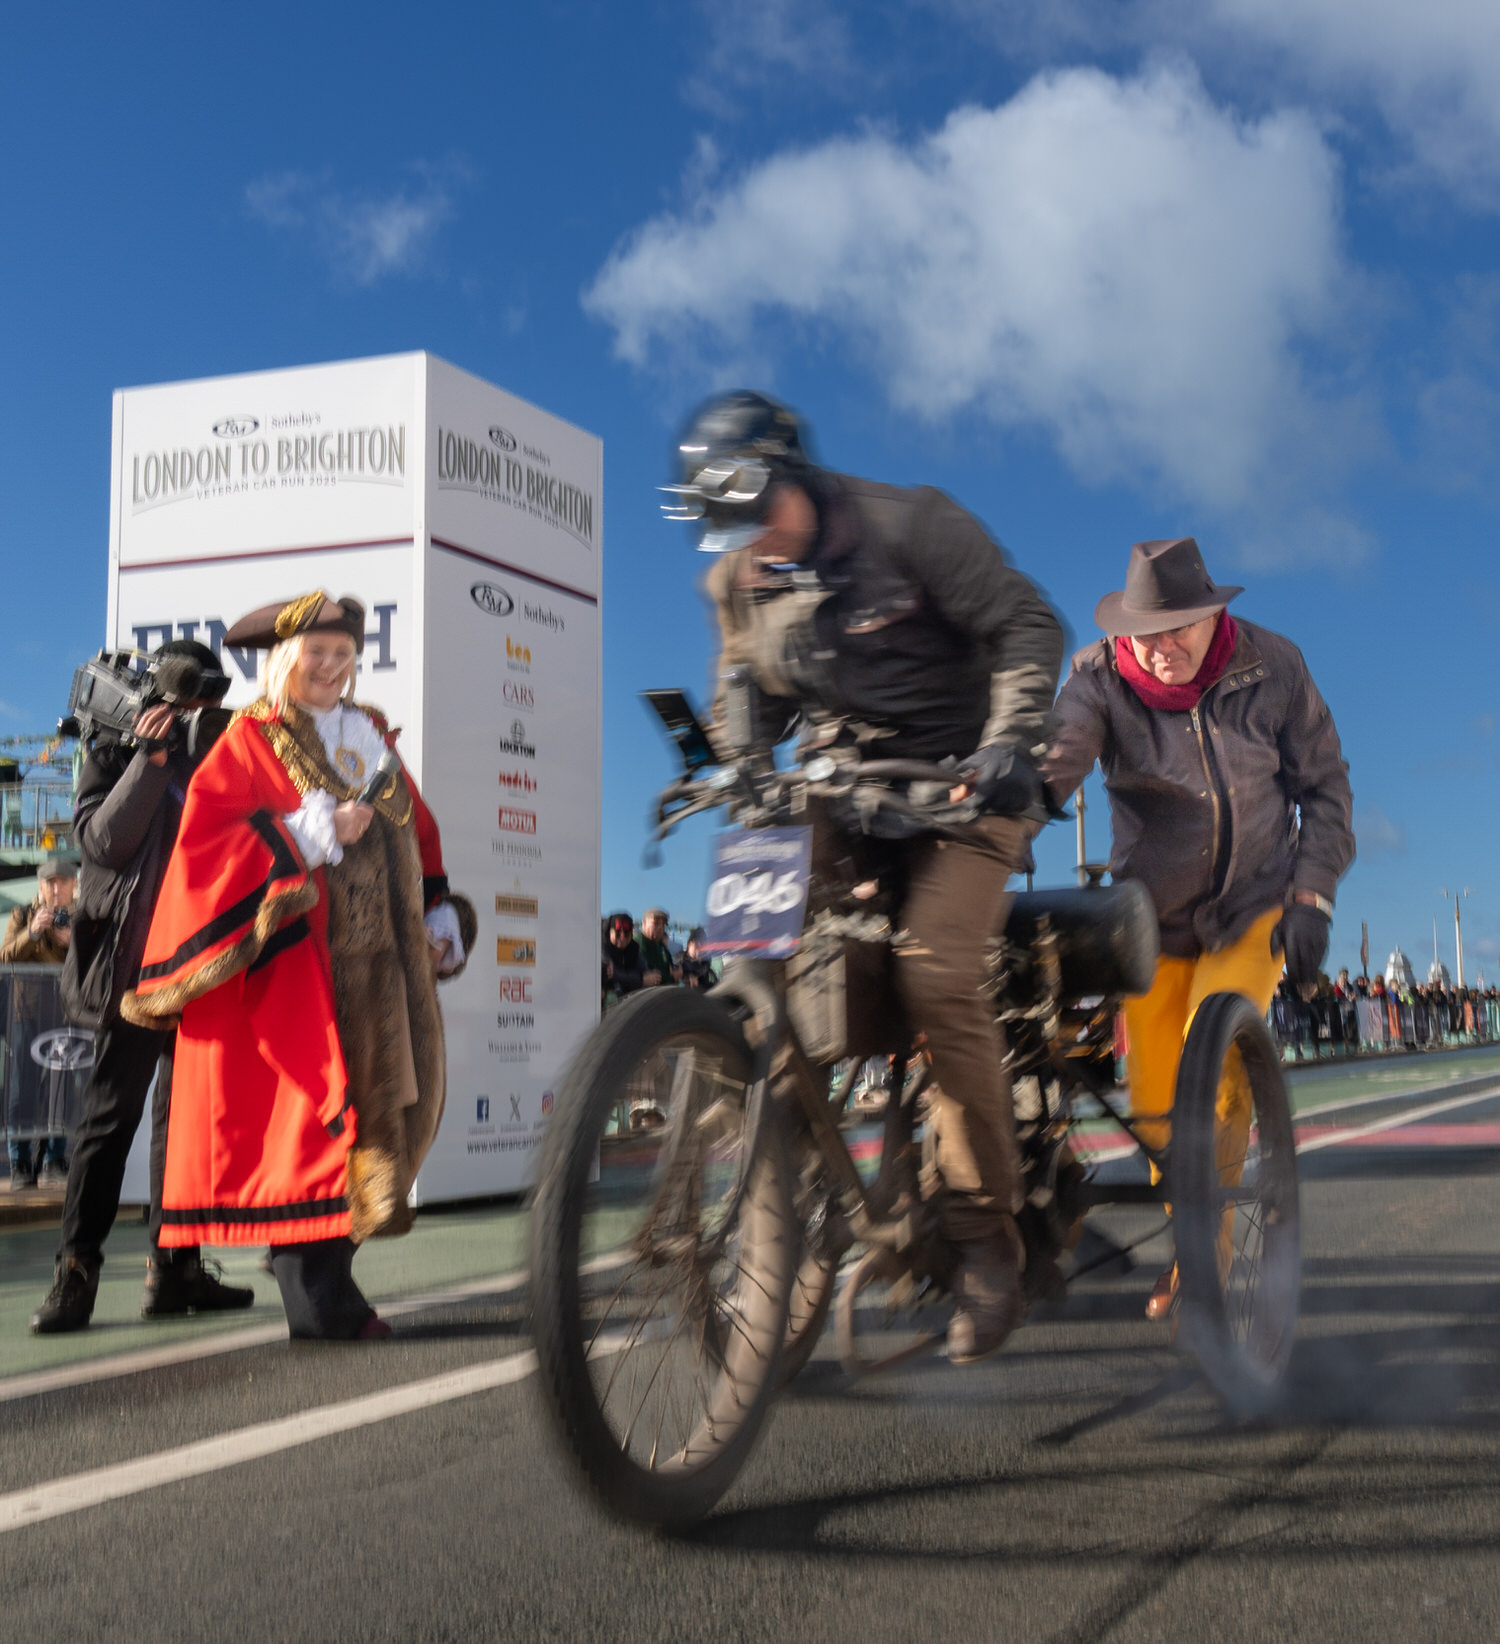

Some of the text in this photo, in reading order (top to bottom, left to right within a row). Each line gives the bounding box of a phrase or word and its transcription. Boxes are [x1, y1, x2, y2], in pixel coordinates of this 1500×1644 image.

[132, 422, 406, 506] LONDON TO BRIGHTON
[197, 475, 337, 500] VETERAN CAR RUN 2025
[438, 424, 592, 542] LONDON TO BRIGHTON
[524, 601, 565, 633] Sotheby's
[503, 679, 535, 709] CARS
[499, 736, 536, 759] LOCKTON
[499, 975, 533, 1003] RAC
